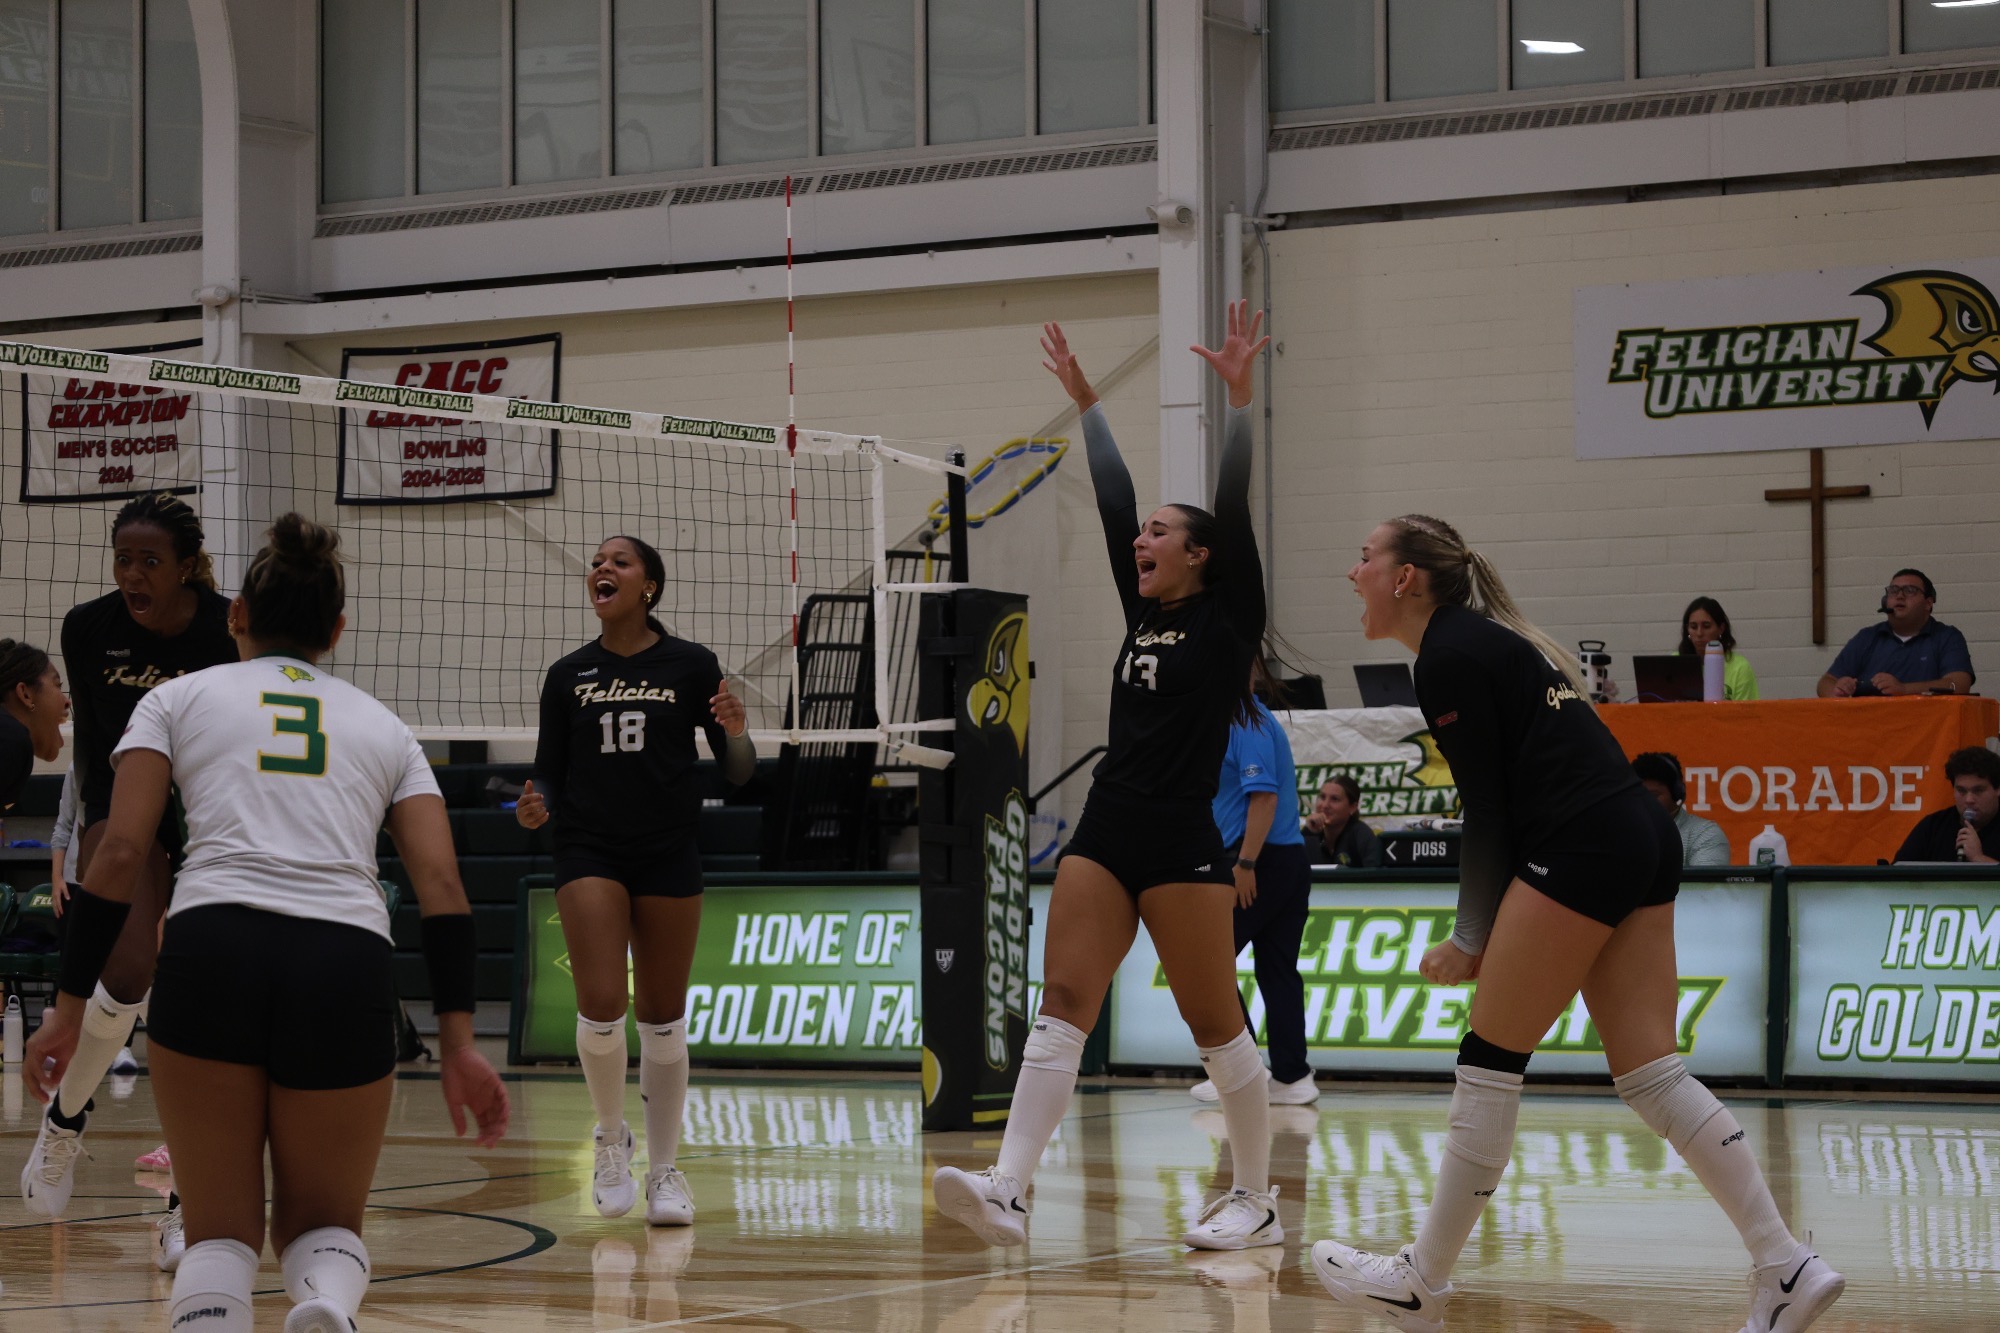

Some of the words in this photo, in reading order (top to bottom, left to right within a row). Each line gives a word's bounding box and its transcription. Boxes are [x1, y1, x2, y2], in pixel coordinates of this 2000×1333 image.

[17, 344, 109, 373] VOLLEYBALL
[1611, 321, 1856, 380] FELICIAN
[149, 360, 218, 383] FELICIAN
[216, 367, 300, 394] VOLLEYBALL
[337, 381, 398, 404] FELICIAN
[396, 388, 473, 413] VOLLEYBALL
[1646, 357, 1952, 416] UNIVERSITY
[48, 395, 190, 428] CHAMPION
[507, 400, 562, 420] FELICIAN
[560, 405, 631, 428] VOLLEYBALL
[662, 416, 713, 434] FELICIAN
[711, 421, 776, 443] VOLLEYBALL
[57, 439, 105, 458] MEN'S
[111, 434, 177, 456] SOCCER
[404, 438, 486, 459] BOWLING
[98, 465, 134, 483] 2024
[574, 678, 676, 707] Felician
[258, 691, 328, 777] 3
[599, 711, 646, 753] 18
[1684, 765, 1923, 812] TORADE
[1004, 791, 1026, 1016] GOLDEN
[729, 912, 849, 966] HOME
[854, 911, 911, 967] OF
[984, 817, 1007, 1067] FALCONS
[1881, 905, 2000, 970] HOM
[685, 982, 857, 1047] GOLDEN
[1818, 983, 2000, 1064] GOLDE
